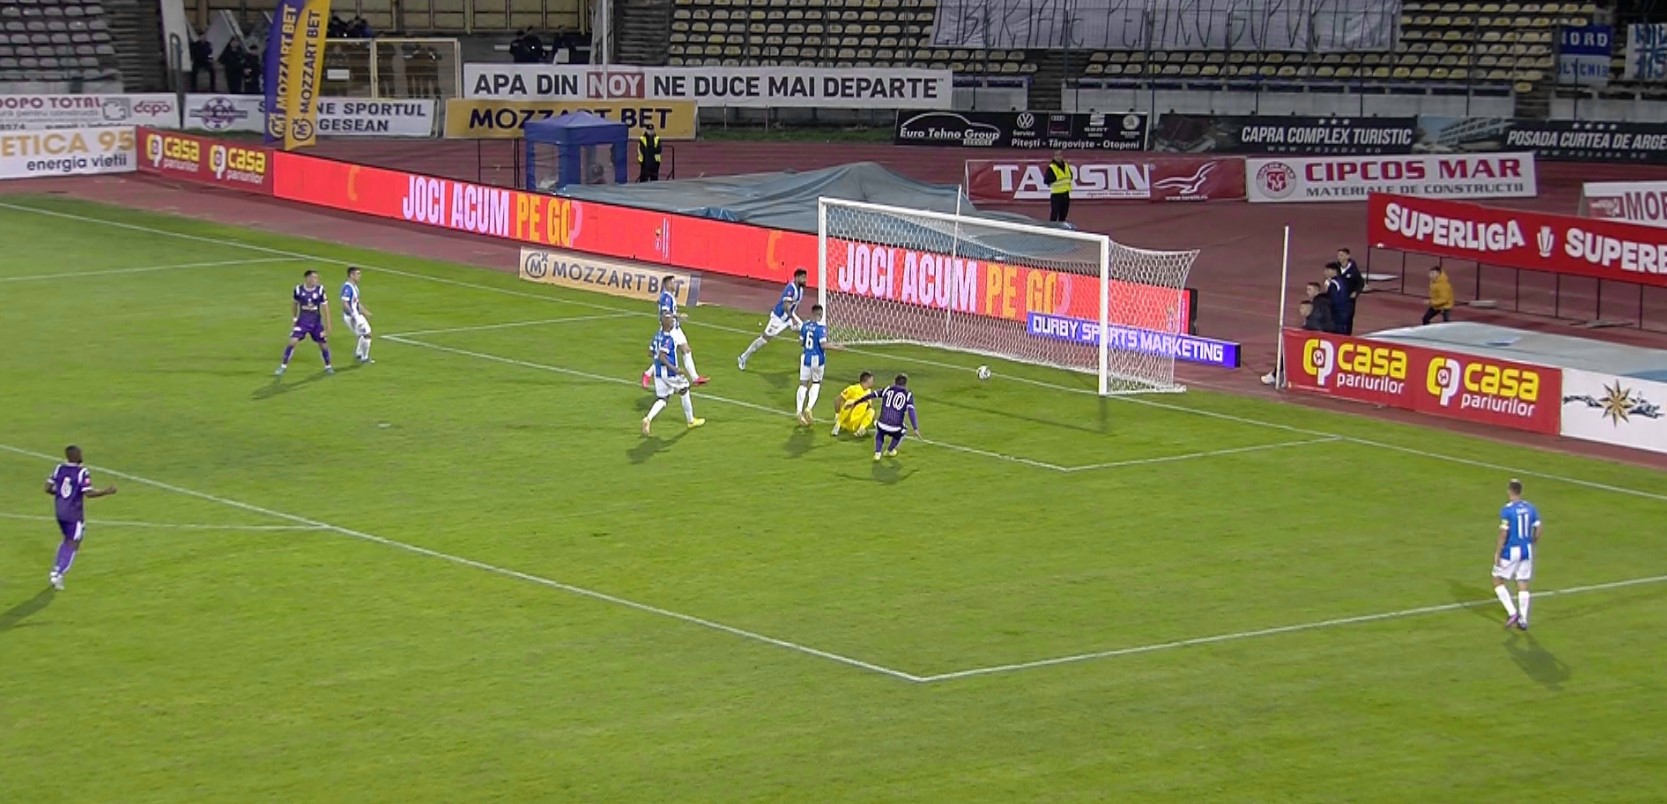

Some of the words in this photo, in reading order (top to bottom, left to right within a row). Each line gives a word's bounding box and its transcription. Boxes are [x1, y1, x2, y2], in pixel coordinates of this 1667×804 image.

[307, 10, 320, 38] BET
[300, 42, 317, 113] MOZZART
[474, 74, 527, 95] APA
[537, 74, 578, 95] DIN
[589, 73, 643, 97] NOY
[654, 76, 685, 96] NE
[694, 76, 760, 97] DUCE
[768, 76, 815, 97] MAI
[48, 97, 102, 109] TOTAL
[343, 102, 426, 116] SPORTUL
[317, 119, 389, 132] GESEAN
[469, 108, 612, 129] MOZZT
[621, 107, 672, 129] BET
[98, 130, 136, 152] 95
[900, 127, 924, 138] Euro
[928, 127, 962, 139] Tehno
[965, 129, 1000, 142] Group
[1103, 140, 1140, 150] Otopeni
[1241, 126, 1285, 143] CAPRA
[1287, 127, 1351, 145] COMPLEX
[1353, 128, 1412, 146] TURISTIC
[1507, 131, 1559, 147] POSADA
[1559, 132, 1611, 149] CURTEA
[1612, 133, 1631, 149] DE
[163, 136, 200, 161] casa
[227, 147, 266, 173] casa
[26, 156, 87, 172] energia
[1305, 161, 1426, 180] CIPCOS
[1439, 159, 1521, 179] MAR
[1306, 185, 1394, 197] MATERIALE
[1401, 184, 1417, 194] DE
[402, 175, 445, 225] JOCI
[451, 182, 509, 237] ACUM
[516, 192, 541, 242] PE
[1384, 203, 1525, 251] SUPERLIGA
[552, 261, 645, 294] MOZZART
[648, 277, 685, 298] BT
[838, 242, 895, 299] JOCI
[901, 250, 978, 313] ACUM
[985, 263, 1017, 319] PE
[806, 331, 814, 349] 6
[1082, 323, 1138, 347] SPRTS
[1140, 333, 1223, 362] MARKETING
[1337, 342, 1408, 380] casa
[1336, 371, 1405, 395] pariurilor
[1463, 361, 1539, 401] casa
[885, 391, 906, 411] 10
[1461, 391, 1535, 418] pariurilor
[60, 476, 73, 499] 6
[1517, 514, 1529, 539] 11
